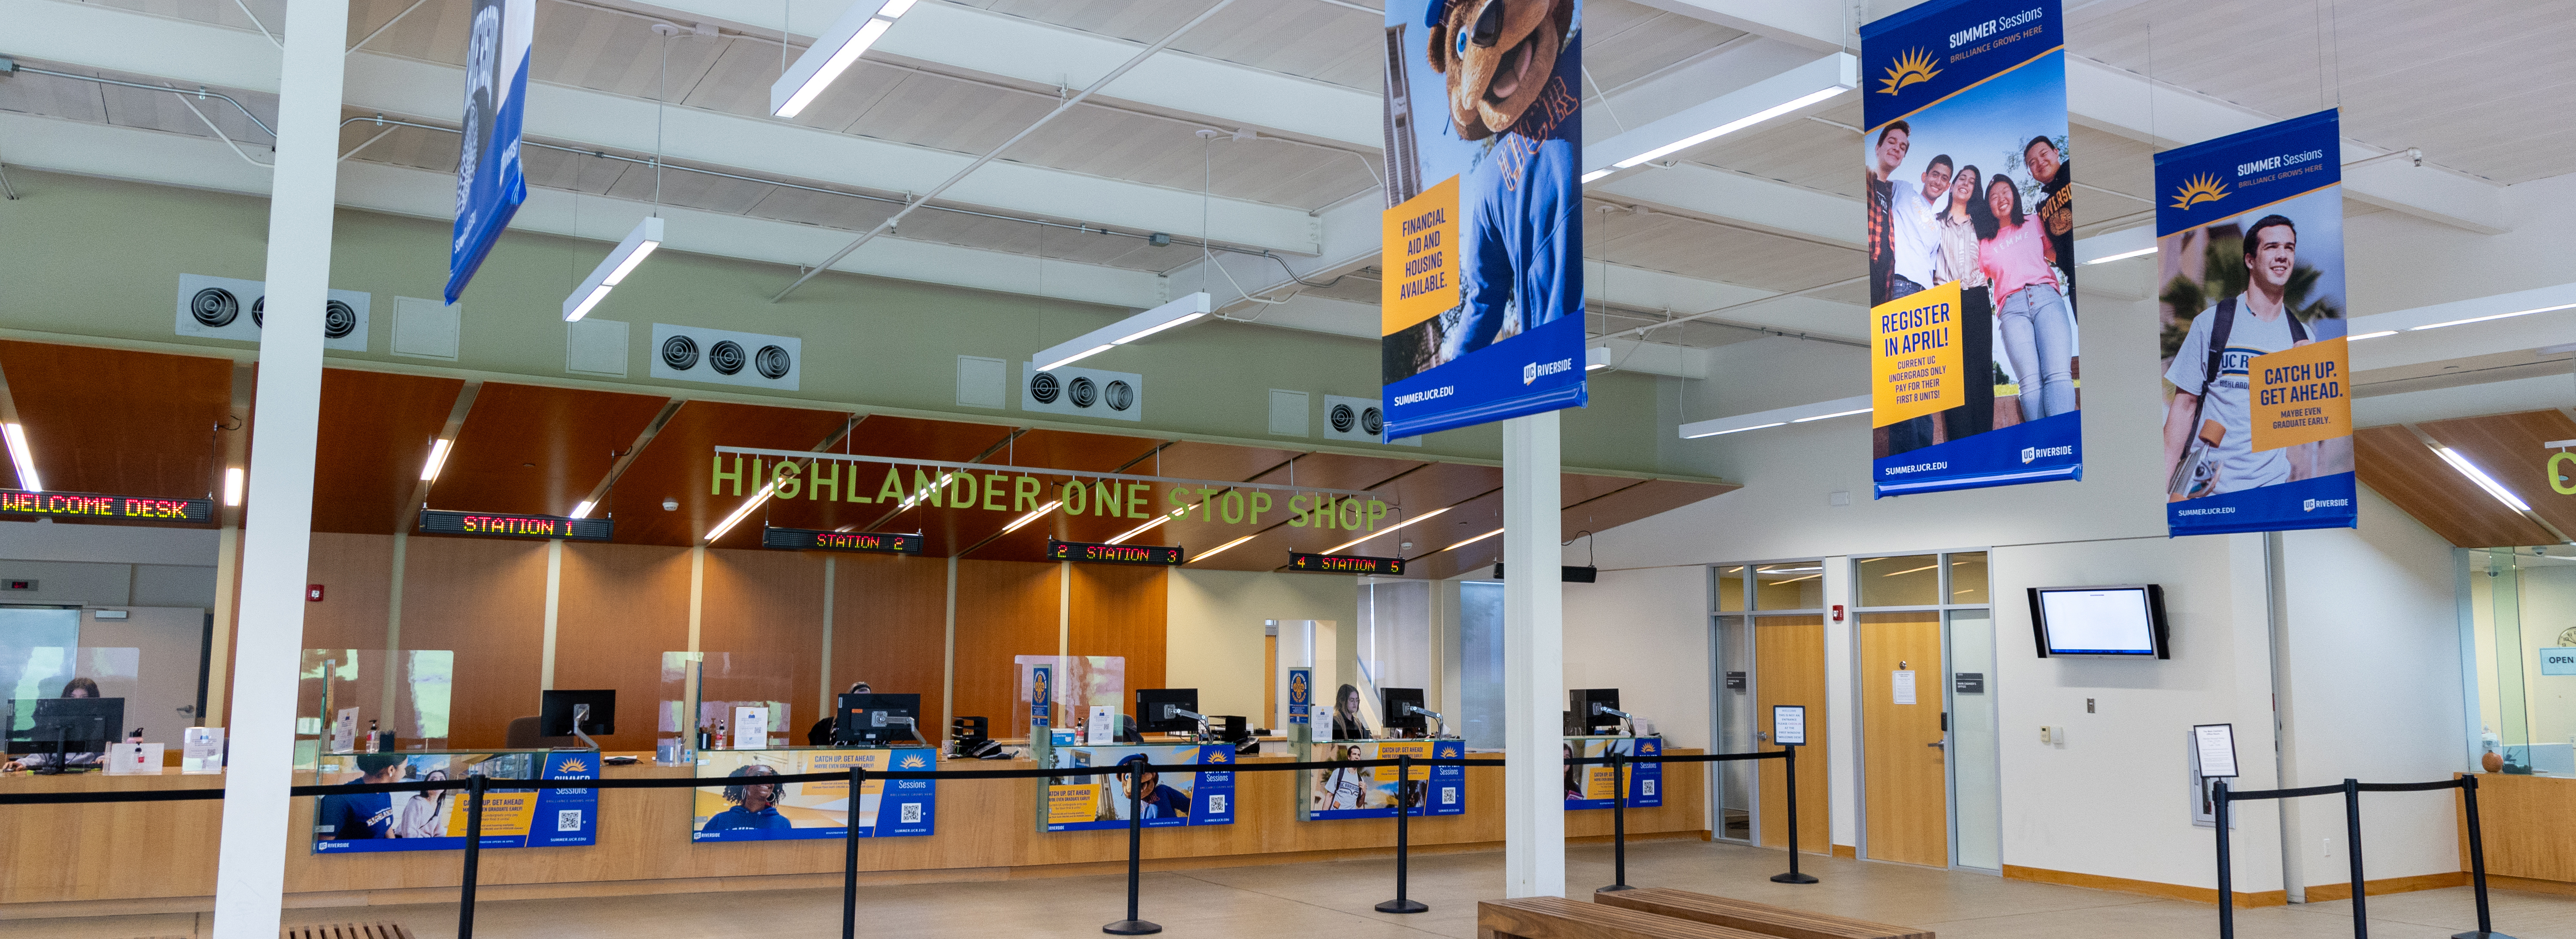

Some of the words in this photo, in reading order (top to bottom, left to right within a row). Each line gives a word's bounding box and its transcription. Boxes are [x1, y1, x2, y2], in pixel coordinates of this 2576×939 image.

[1949, 19, 1996, 48] SUMMER
[1999, 7, 2042, 30] Sessions
[1950, 42, 1990, 63] BRILLIANCE
[1993, 33, 2021, 48] GROWS
[2023, 25, 2042, 38] HERE
[2238, 156, 2281, 177] SUMMER
[2283, 149, 2322, 166] Sessions
[2239, 175, 2275, 188] BRILLIANCE
[2278, 169, 2303, 179] GROWS
[2305, 164, 2323, 173] HERE
[2042, 183, 2072, 221] RIVERSI
[1403, 207, 1446, 237] FINANCIAL
[1407, 237, 1421, 256] AID
[1424, 230, 1440, 251] AND
[1993, 231, 2029, 253] FEMME
[1406, 251, 1442, 278] HOUSING
[1400, 272, 1447, 300] AVAILABLE.
[1882, 303, 1950, 334] REGISTER
[1885, 336, 1898, 357] IN
[1902, 327, 1948, 354] APRIL!
[1526, 365, 1535, 379] UC
[1537, 358, 1572, 377] RIVERSIDE
[1898, 357, 1926, 369] CURRENT
[1927, 356, 1935, 364] UC
[2221, 354, 2237, 368] UC
[1889, 369, 1929, 382] UNDERGRADS
[1931, 366, 1946, 376] ONLY
[2265, 364, 2310, 385] CATCH
[2315, 361, 2337, 379] UP.
[1896, 384, 1906, 393] PAY
[1908, 382, 1920, 391] FOR
[1922, 379, 1939, 389] THEIR
[2220, 380, 2249, 389] HIGHLAND
[2260, 387, 2287, 406] GET
[2290, 381, 2343, 403] AHEAD.
[1394, 385, 1454, 406] SUMMER.UCR.EDU
[1897, 394, 1913, 404] FIRST
[1914, 393, 1918, 402] 8
[1920, 390, 1940, 400] UNITS!
[2273, 418, 2306, 429] GRADUATE
[2308, 416, 2330, 425] EARLY.
[2281, 408, 2303, 418] MAYBE
[2305, 407, 2321, 416] EVEN
[2024, 449, 2033, 459] UC
[2036, 445, 2072, 458] RIVERSIDE
[1886, 461, 1947, 476] SUMMER.UCR.EDU
[712, 456, 1041, 512] HIGHLANDER
[1062, 480, 1149, 519] ONE
[1169, 487, 1272, 524] STOP
[1288, 495, 1387, 531] SHOP
[2316, 499, 2348, 508] RIVERSIDE
[3, 493, 113, 515] WELCOME
[125, 499, 188, 518] DESK
[2178, 507, 2236, 516] SUMMER.UCR.EDU
[464, 516, 554, 535] STATION
[565, 521, 573, 536] 1
[817, 534, 879, 549] STATION
[895, 538, 904, 550] 2
[1057, 545, 1066, 558] 2
[1087, 546, 1148, 561] STATION
[1168, 551, 1176, 563] 3
[1298, 557, 1305, 568] 4
[1322, 558, 1376, 571] STATION
[1391, 561, 1399, 572] 5
[899, 780, 926, 789] Sessions
